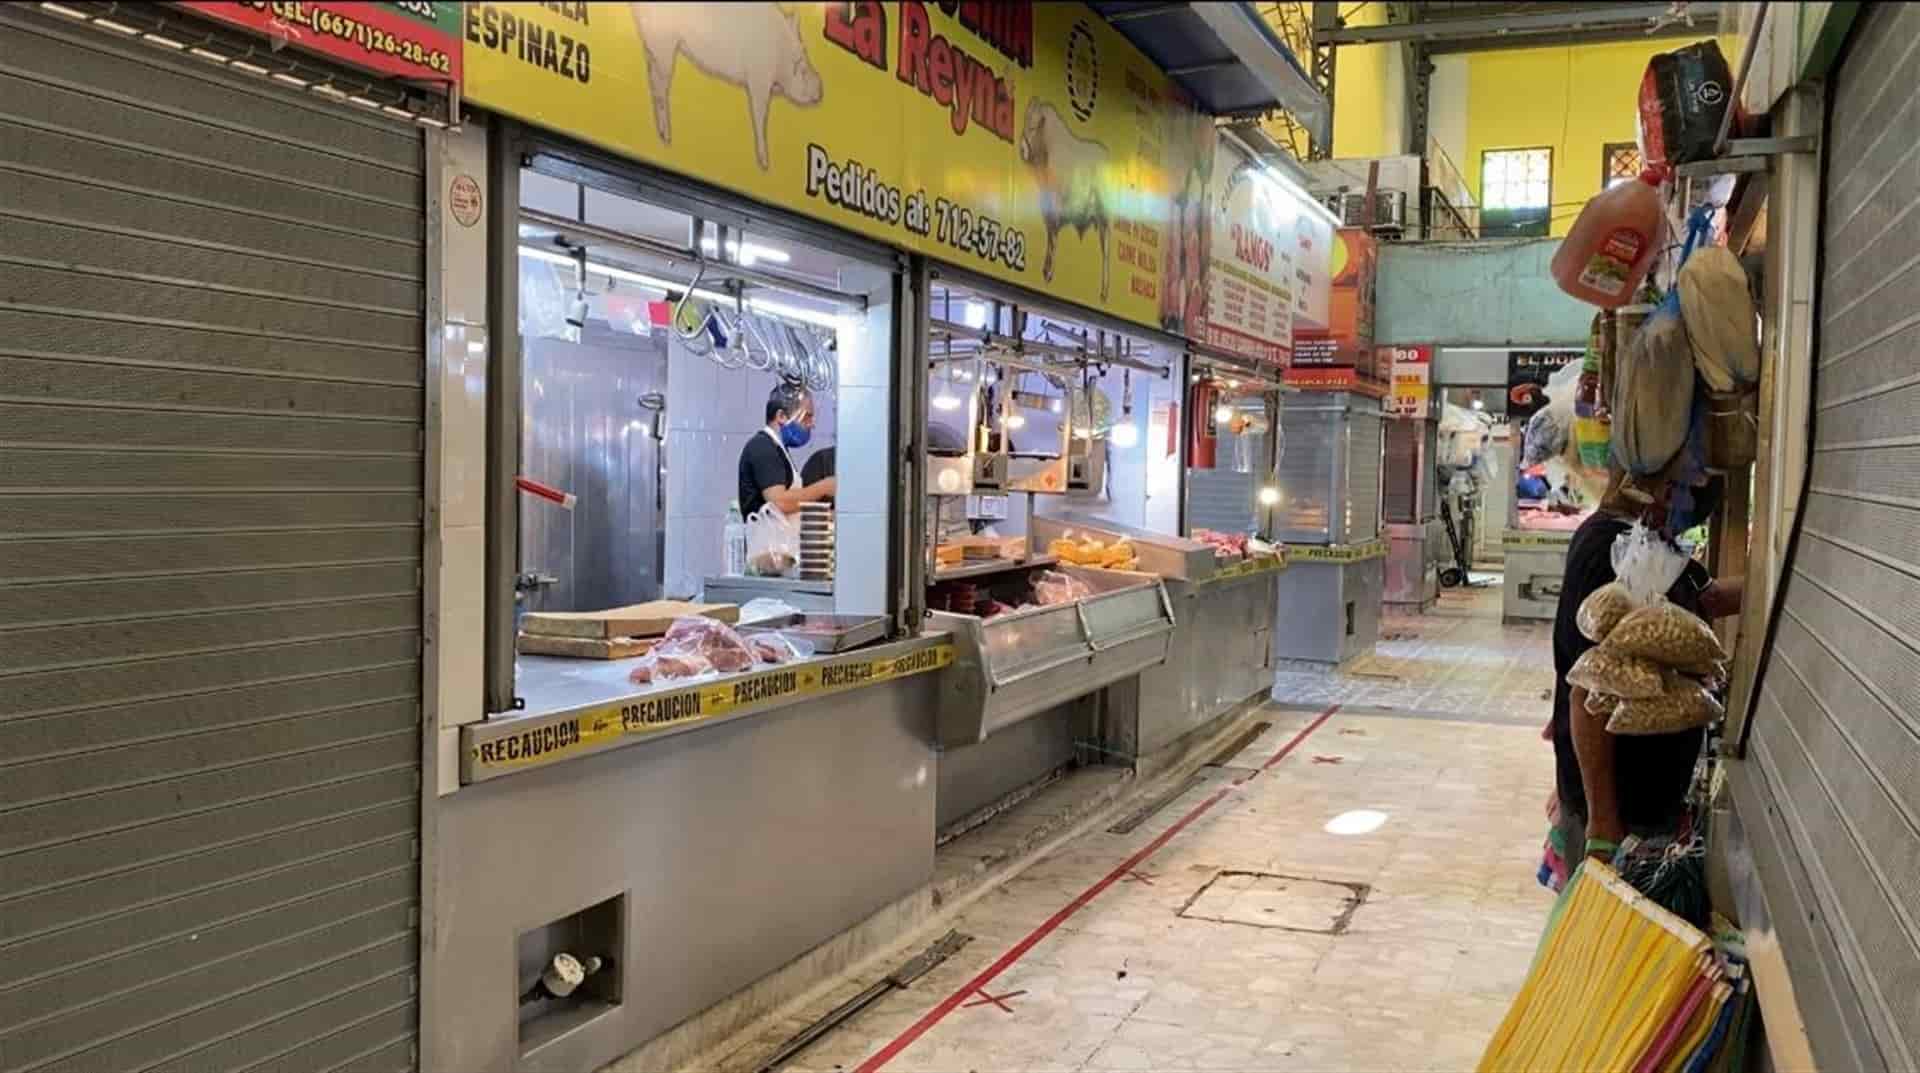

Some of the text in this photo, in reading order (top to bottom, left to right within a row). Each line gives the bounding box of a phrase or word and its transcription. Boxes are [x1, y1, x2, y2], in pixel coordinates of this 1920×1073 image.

[465, 5, 591, 84] ESPINAZO
[896, 2, 1015, 144] Reyna
[806, 143, 1026, 271] Pedidos al: 712-37-82
[621, 692, 701, 731] PRECAUCION
[734, 671, 798, 704] PRECAUCION
